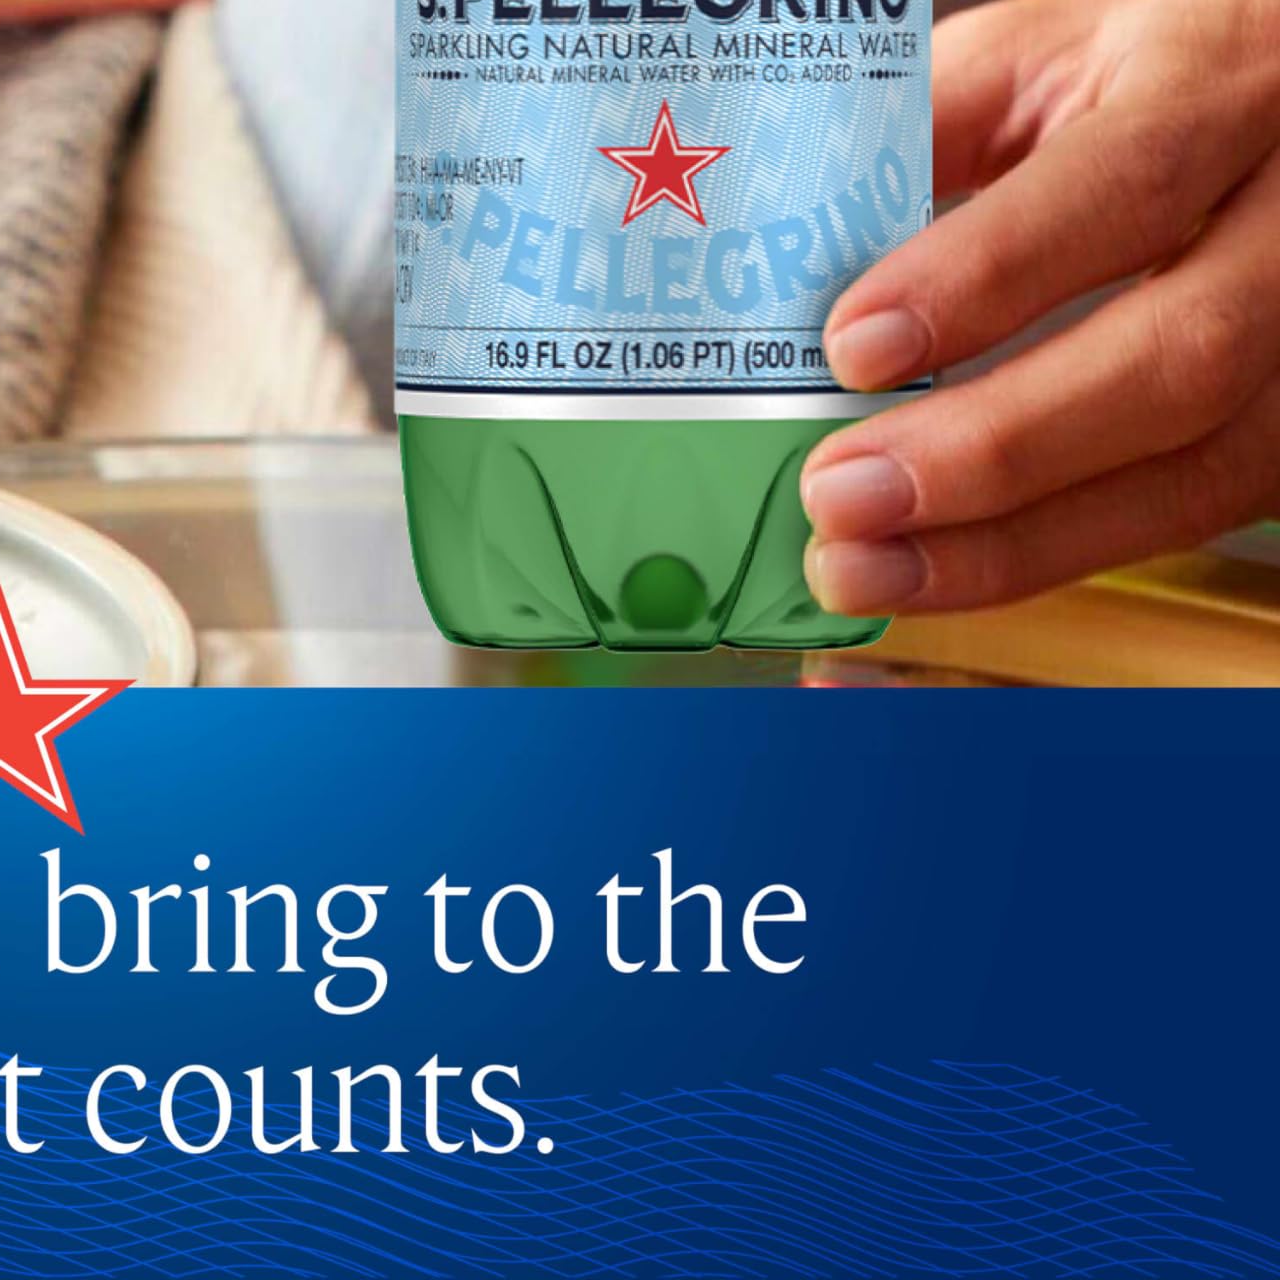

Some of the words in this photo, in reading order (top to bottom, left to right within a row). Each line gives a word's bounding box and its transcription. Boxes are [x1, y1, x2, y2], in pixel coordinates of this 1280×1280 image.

[410, 33, 529, 60] SPARKLING
[544, 33, 698, 59] NATURAL
[713, 32, 848, 59] MINERAL
[858, 32, 918, 59] WATER
[476, 65, 544, 84] NATURAL
[552, 65, 632, 84] MINERAL
[640, 64, 699, 84] WATER
[708, 64, 755, 83] WITH
[801, 64, 852, 83] ADDED
[485, 341, 529, 369] 16.9
[536, 341, 566, 369] FL
[574, 341, 613, 369] OZ
[622, 341, 685, 375] (1.06
[693, 341, 735, 375] PT)
[744, 341, 794, 375] (500
